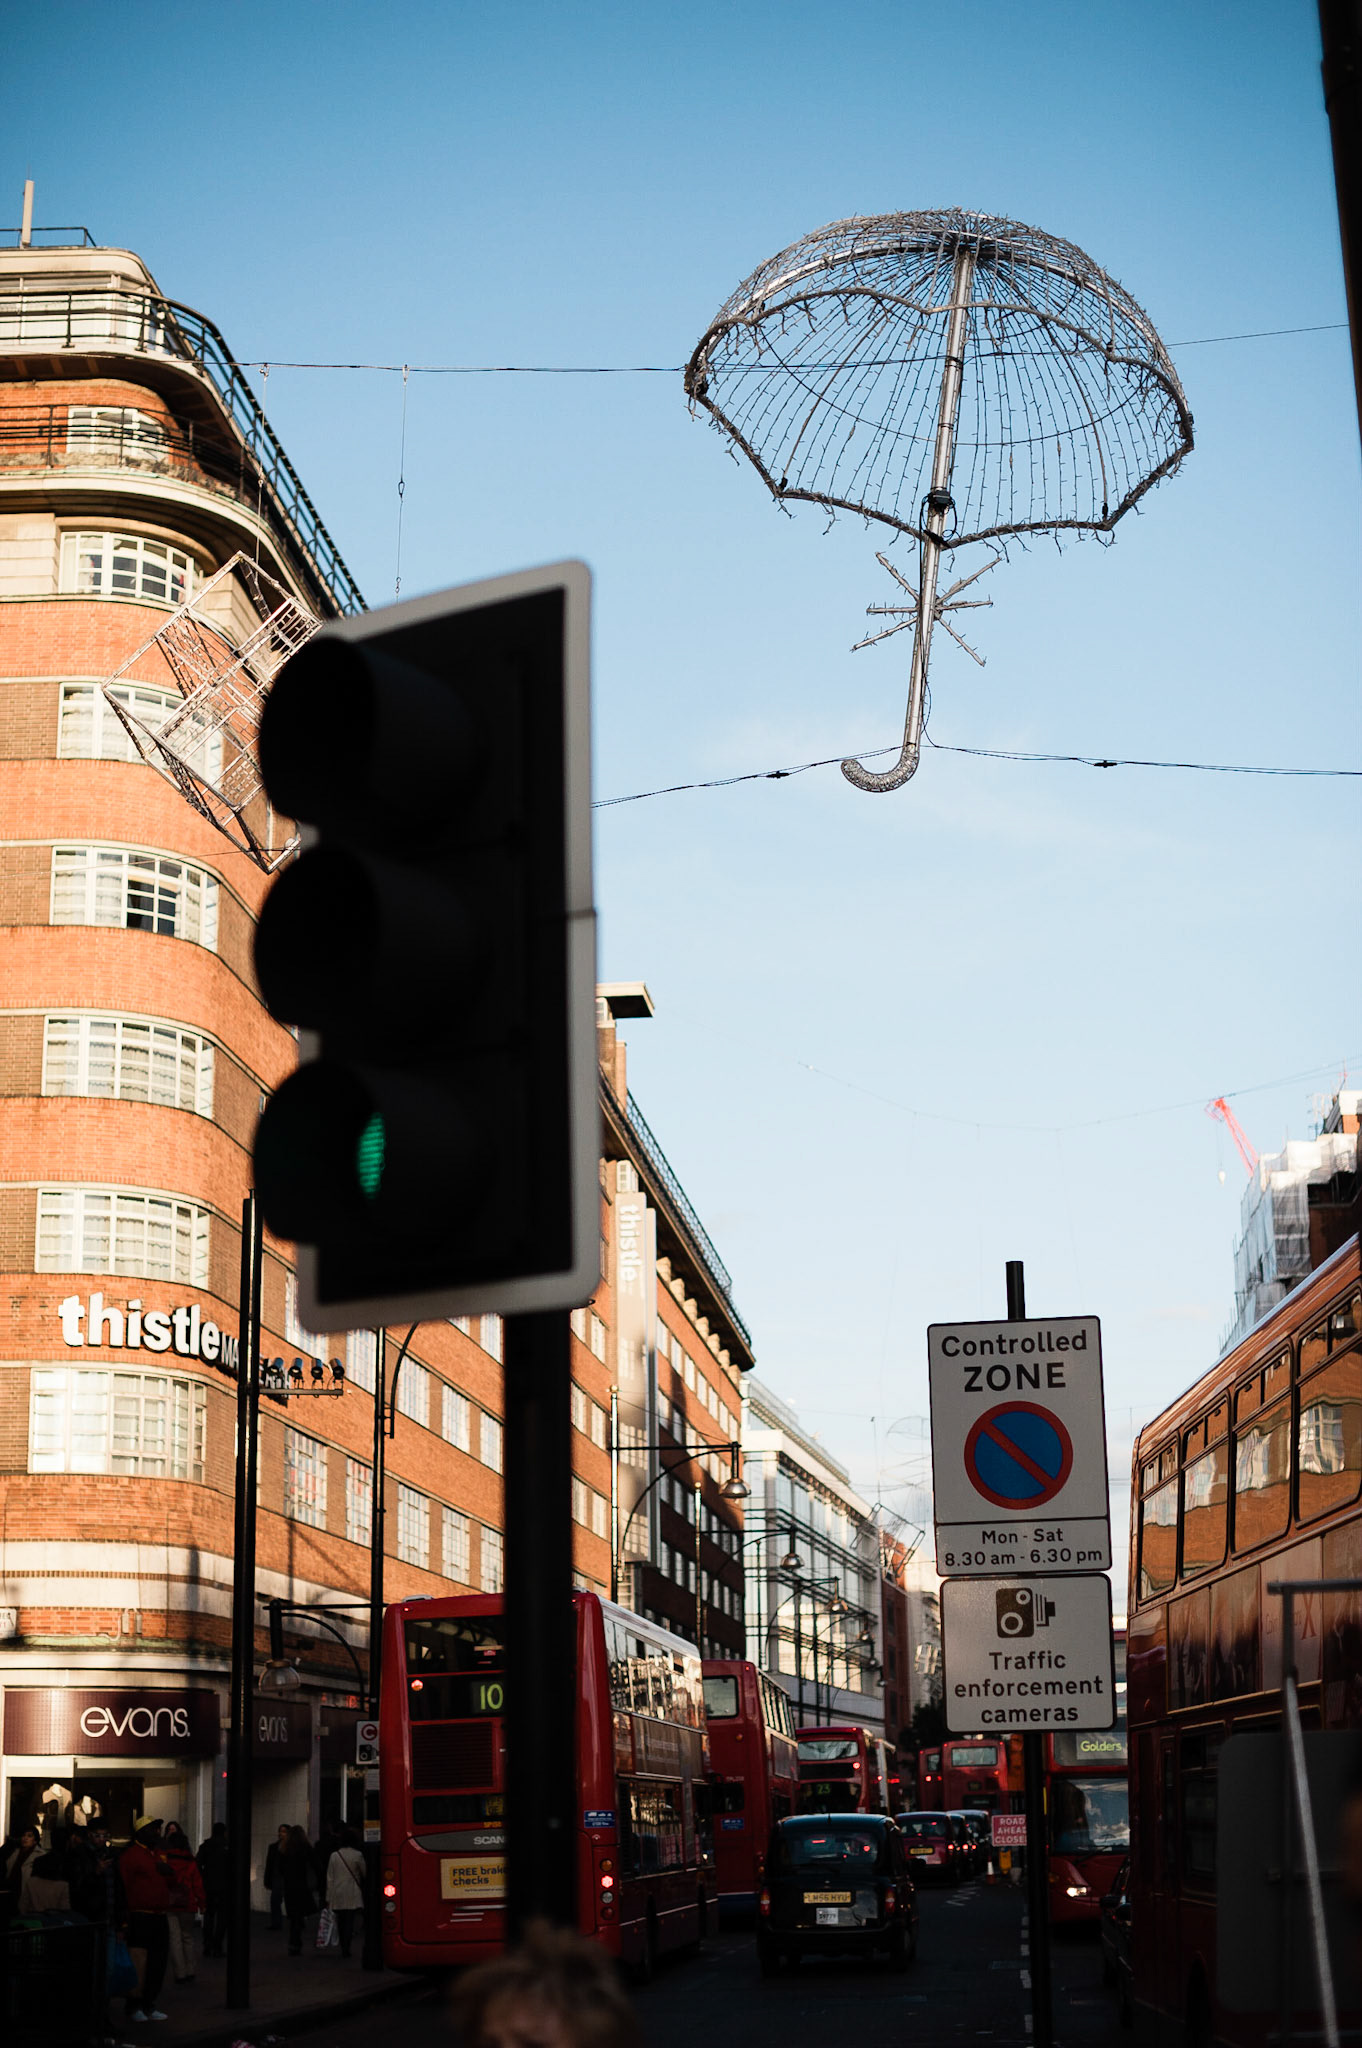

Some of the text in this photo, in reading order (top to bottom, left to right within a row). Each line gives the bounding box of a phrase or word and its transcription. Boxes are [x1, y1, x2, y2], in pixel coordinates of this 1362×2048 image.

[619, 1204, 642, 1283] thistle
[58, 1291, 220, 1361] thistle
[940, 1328, 1088, 1358] Controlled
[963, 1361, 1067, 1393] ZONE
[981, 1529, 1019, 1545] Mon
[1032, 1527, 1064, 1543] Sat
[944, 1550, 986, 1568] 8.30
[990, 1553, 1016, 1566] am
[1029, 1547, 1072, 1564] 6.30
[1075, 1549, 1103, 1565] pm
[988, 1649, 1067, 1671] Traffic
[480, 1683, 502, 1710] 10
[954, 1674, 1104, 1699] enforcement
[980, 1706, 1079, 1725] cameras
[1080, 1740, 1123, 1752] Golders
[999, 1817, 1026, 1826] ROAD
[452, 1867, 478, 1877] FREE
[452, 1876, 490, 1886] checks
